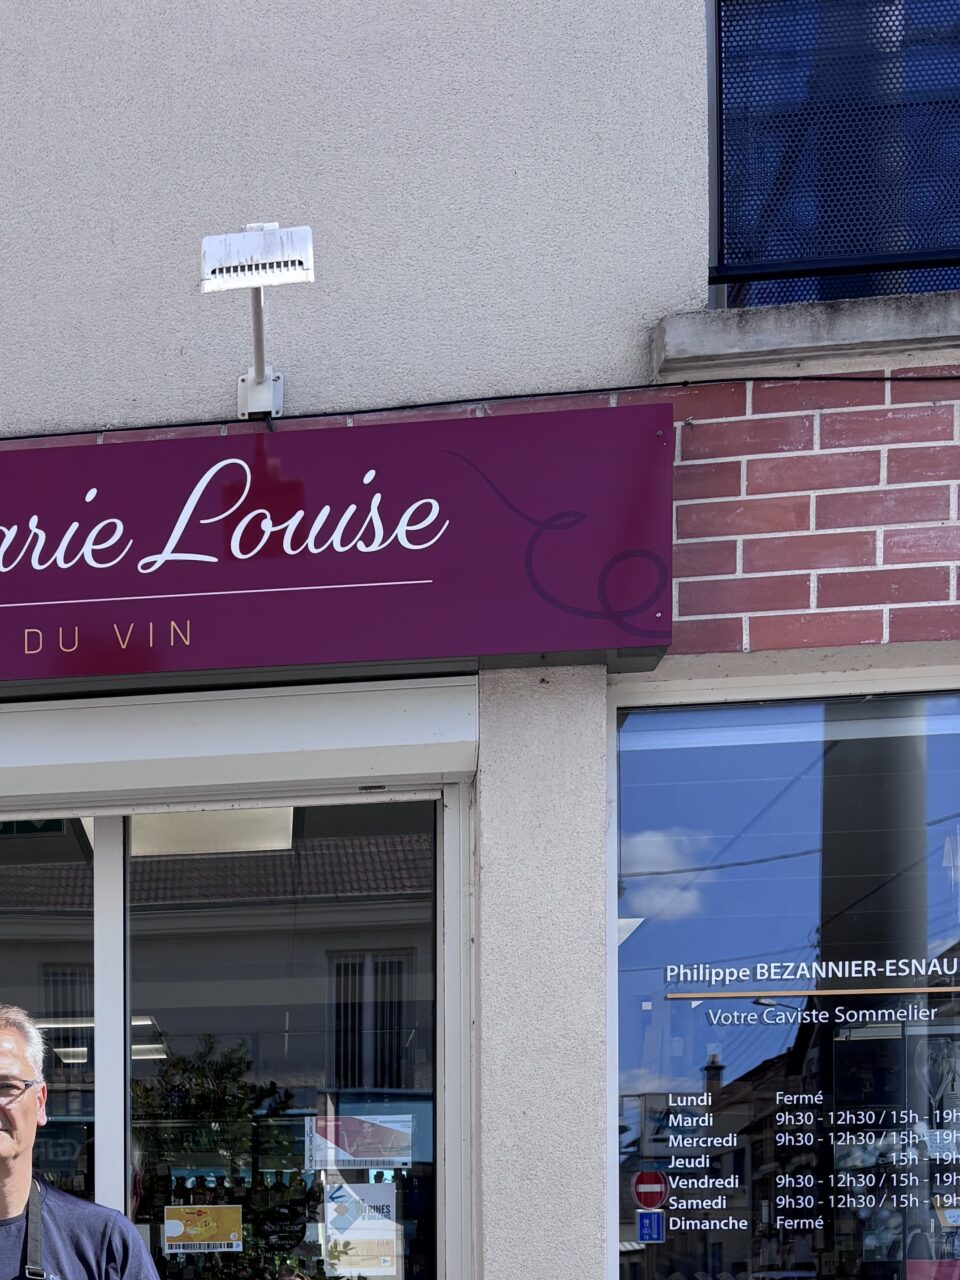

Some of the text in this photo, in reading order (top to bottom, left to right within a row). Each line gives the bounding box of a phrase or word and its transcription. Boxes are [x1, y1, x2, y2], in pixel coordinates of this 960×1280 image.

[137, 458, 450, 574] Louise
[24, 626, 80, 655] DU
[113, 619, 191, 649] VIN
[666, 957, 959, 985] Philippe BEZANNIER-ESNAU
[708, 1004, 938, 1025] Votre Caviste Sommelier
[668, 1091, 823, 1107] Lundi Fermé
[668, 1113, 713, 1127] Mardi
[775, 1112, 814, 1126] 9h30
[828, 1111, 875, 1125] 12h30
[890, 1110, 919, 1124] 15h
[668, 1133, 737, 1148] Mercredi
[775, 1132, 814, 1146] 9h30
[828, 1132, 875, 1146] 12h30
[890, 1131, 919, 1145] 15h
[668, 1154, 710, 1169] Jeudi
[890, 1152, 919, 1166] 15h
[668, 1175, 739, 1189] Vendredi
[775, 1174, 814, 1188] 9h30
[828, 1174, 875, 1188] 12h30
[890, 1172, 919, 1186] 15h
[669, 1196, 727, 1210] Samedi
[775, 1195, 814, 1209] 9h30
[828, 1194, 875, 1208] 12h30
[890, 1193, 919, 1207] 15h
[669, 1215, 824, 1231] Dimanche Fermé
